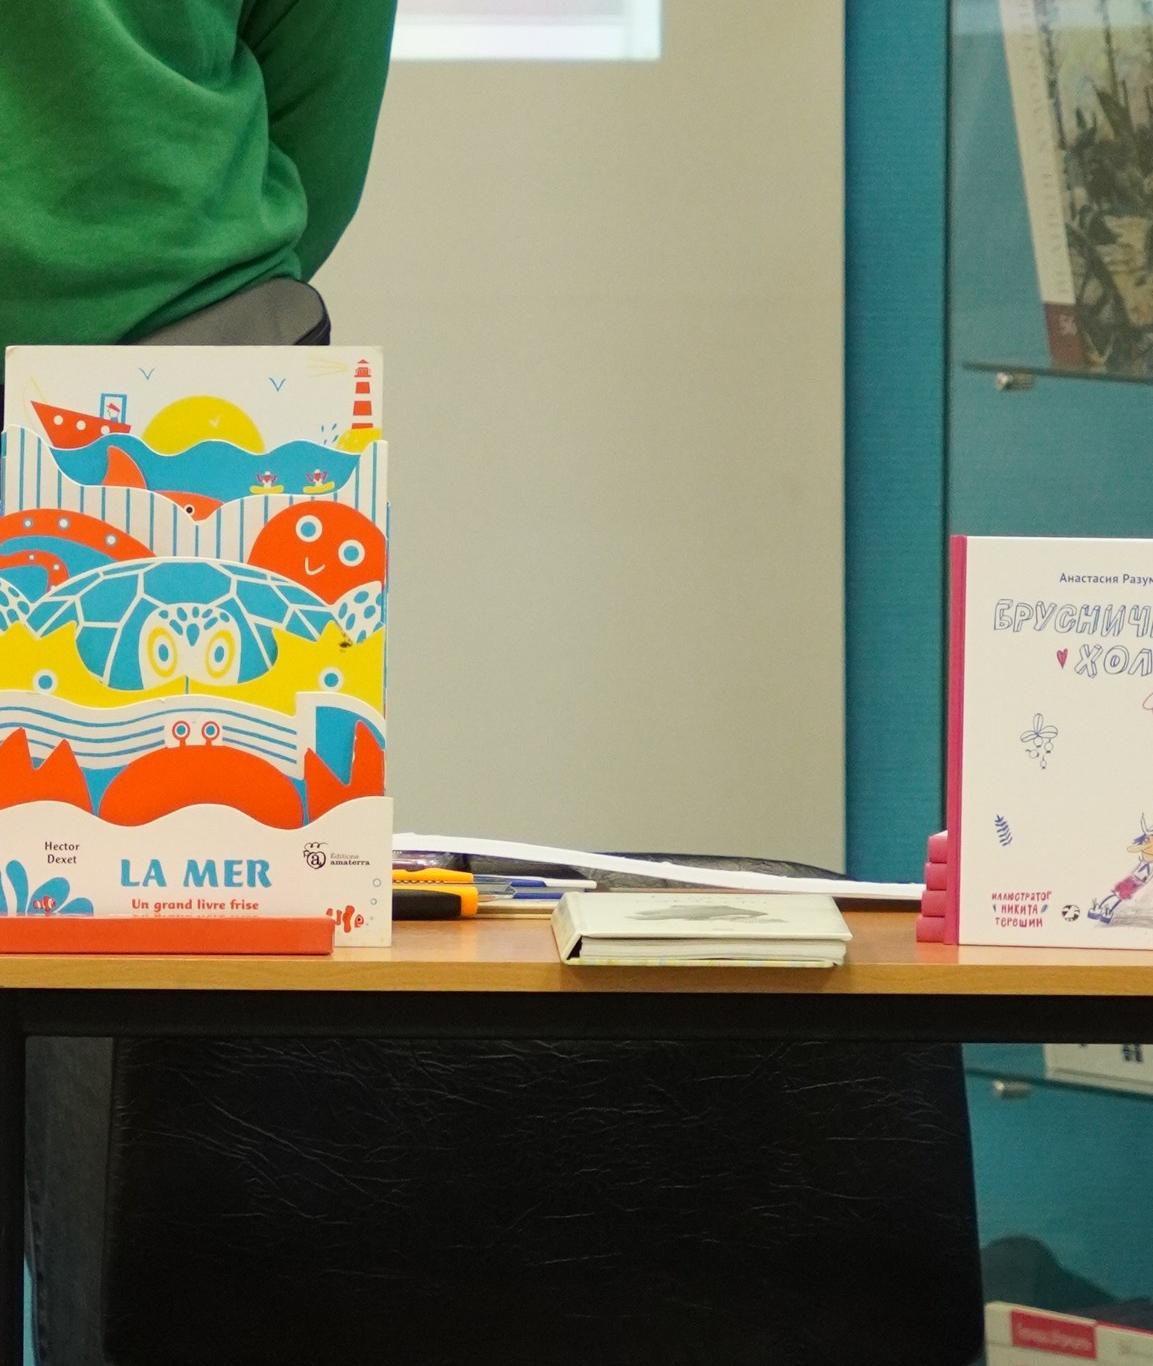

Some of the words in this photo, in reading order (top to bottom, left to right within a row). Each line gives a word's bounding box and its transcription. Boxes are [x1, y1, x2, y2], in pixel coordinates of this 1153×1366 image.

[1059, 573, 1119, 583] Анастасия
[994, 598, 1153, 638] БРУСНИЧ
[44, 841, 80, 851] Hector
[47, 854, 77, 864] Dexet
[120, 859, 167, 888] LA
[183, 859, 272, 888] MER
[132, 899, 149, 910] Un
[154, 899, 192, 913] grand
[198, 899, 226, 910] livre
[230, 899, 259, 910] frise
[1001, 904, 1038, 915] НИКИТА
